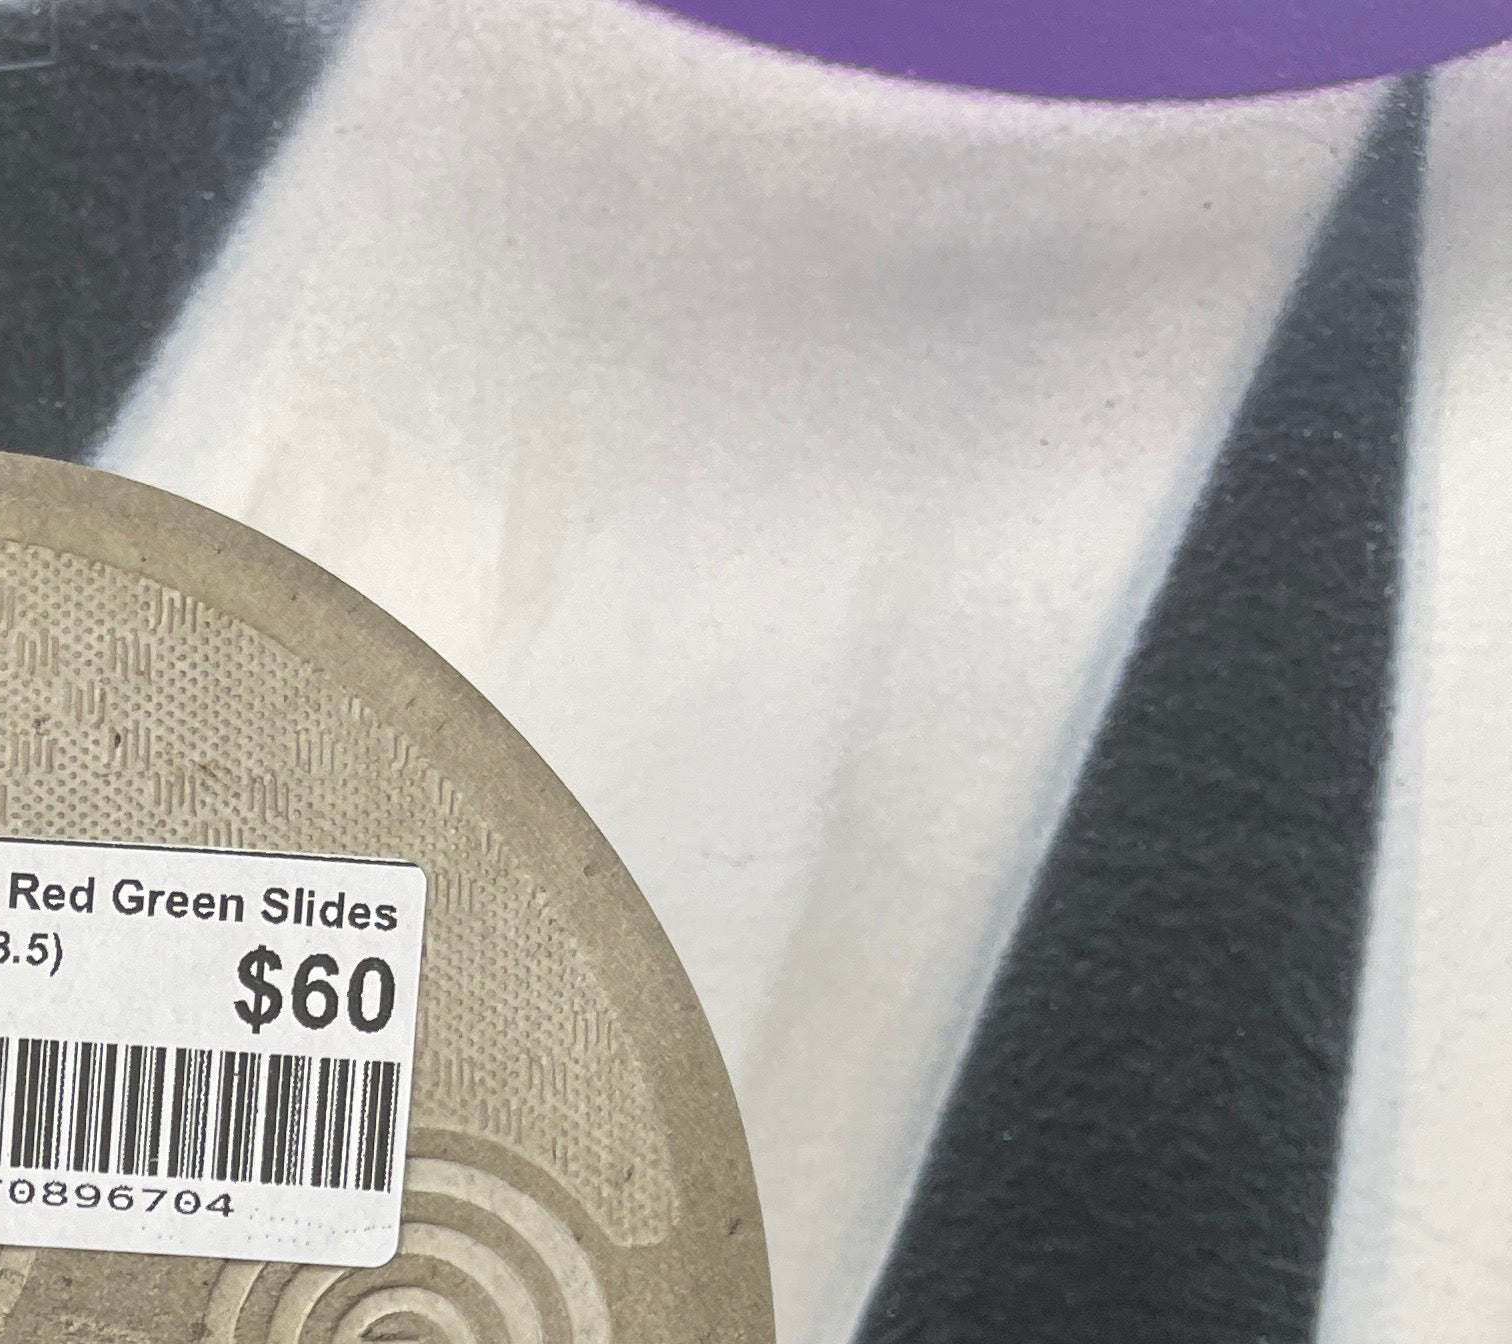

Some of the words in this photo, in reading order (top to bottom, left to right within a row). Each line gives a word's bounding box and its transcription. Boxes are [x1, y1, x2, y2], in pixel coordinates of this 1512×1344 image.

[9, 873, 94, 913] Red
[113, 880, 243, 922] Green
[261, 888, 397, 931] Slides
[234, 945, 395, 1034] $60
